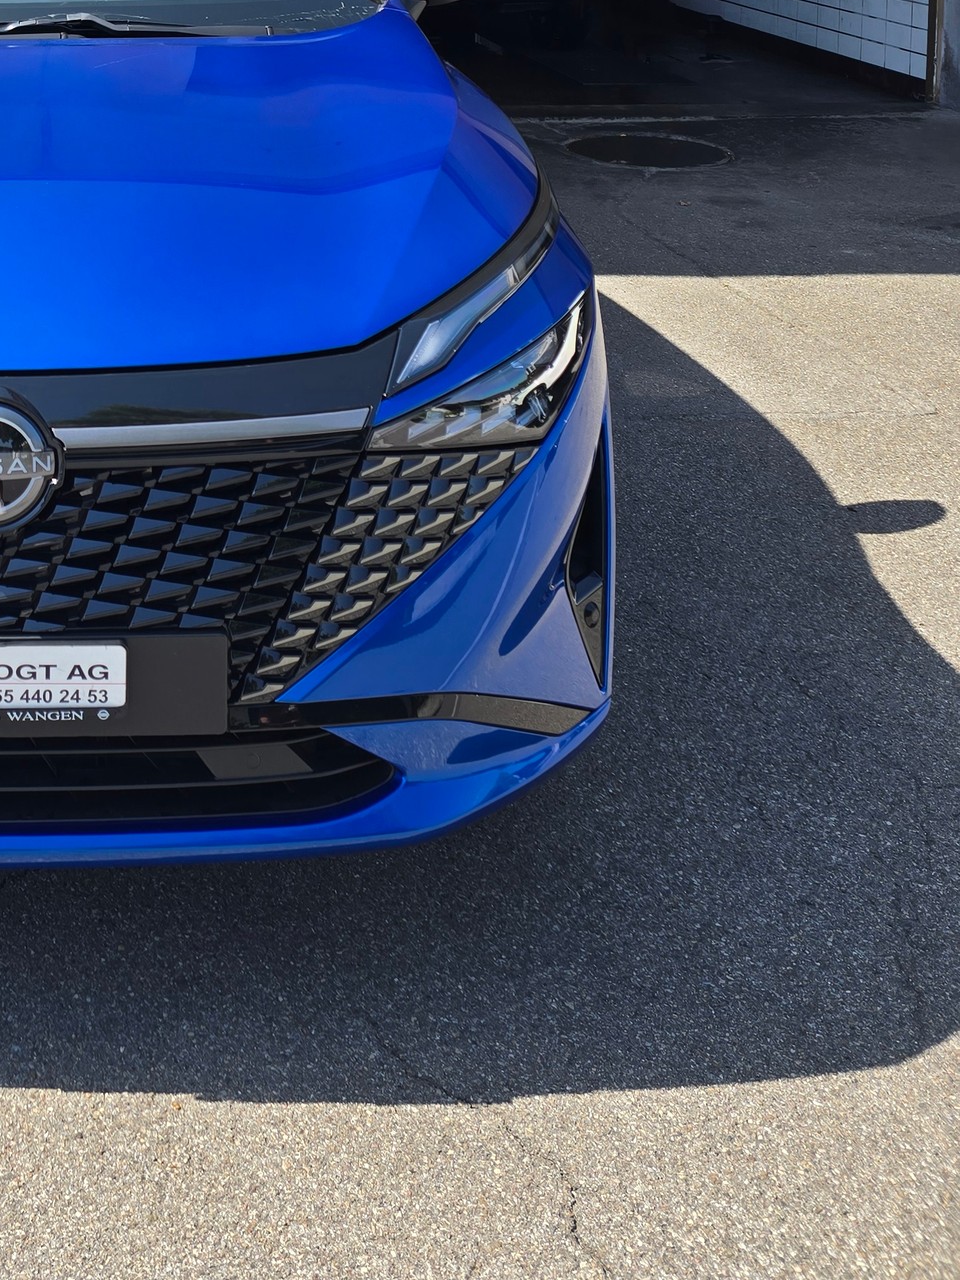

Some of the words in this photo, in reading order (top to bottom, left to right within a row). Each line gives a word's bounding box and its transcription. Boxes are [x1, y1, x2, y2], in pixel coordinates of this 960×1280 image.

[67, 664, 109, 680] AG
[20, 689, 52, 704] 440
[59, 689, 80, 704] 24
[88, 689, 109, 704] 53
[7, 710, 84, 721] WANGEN
